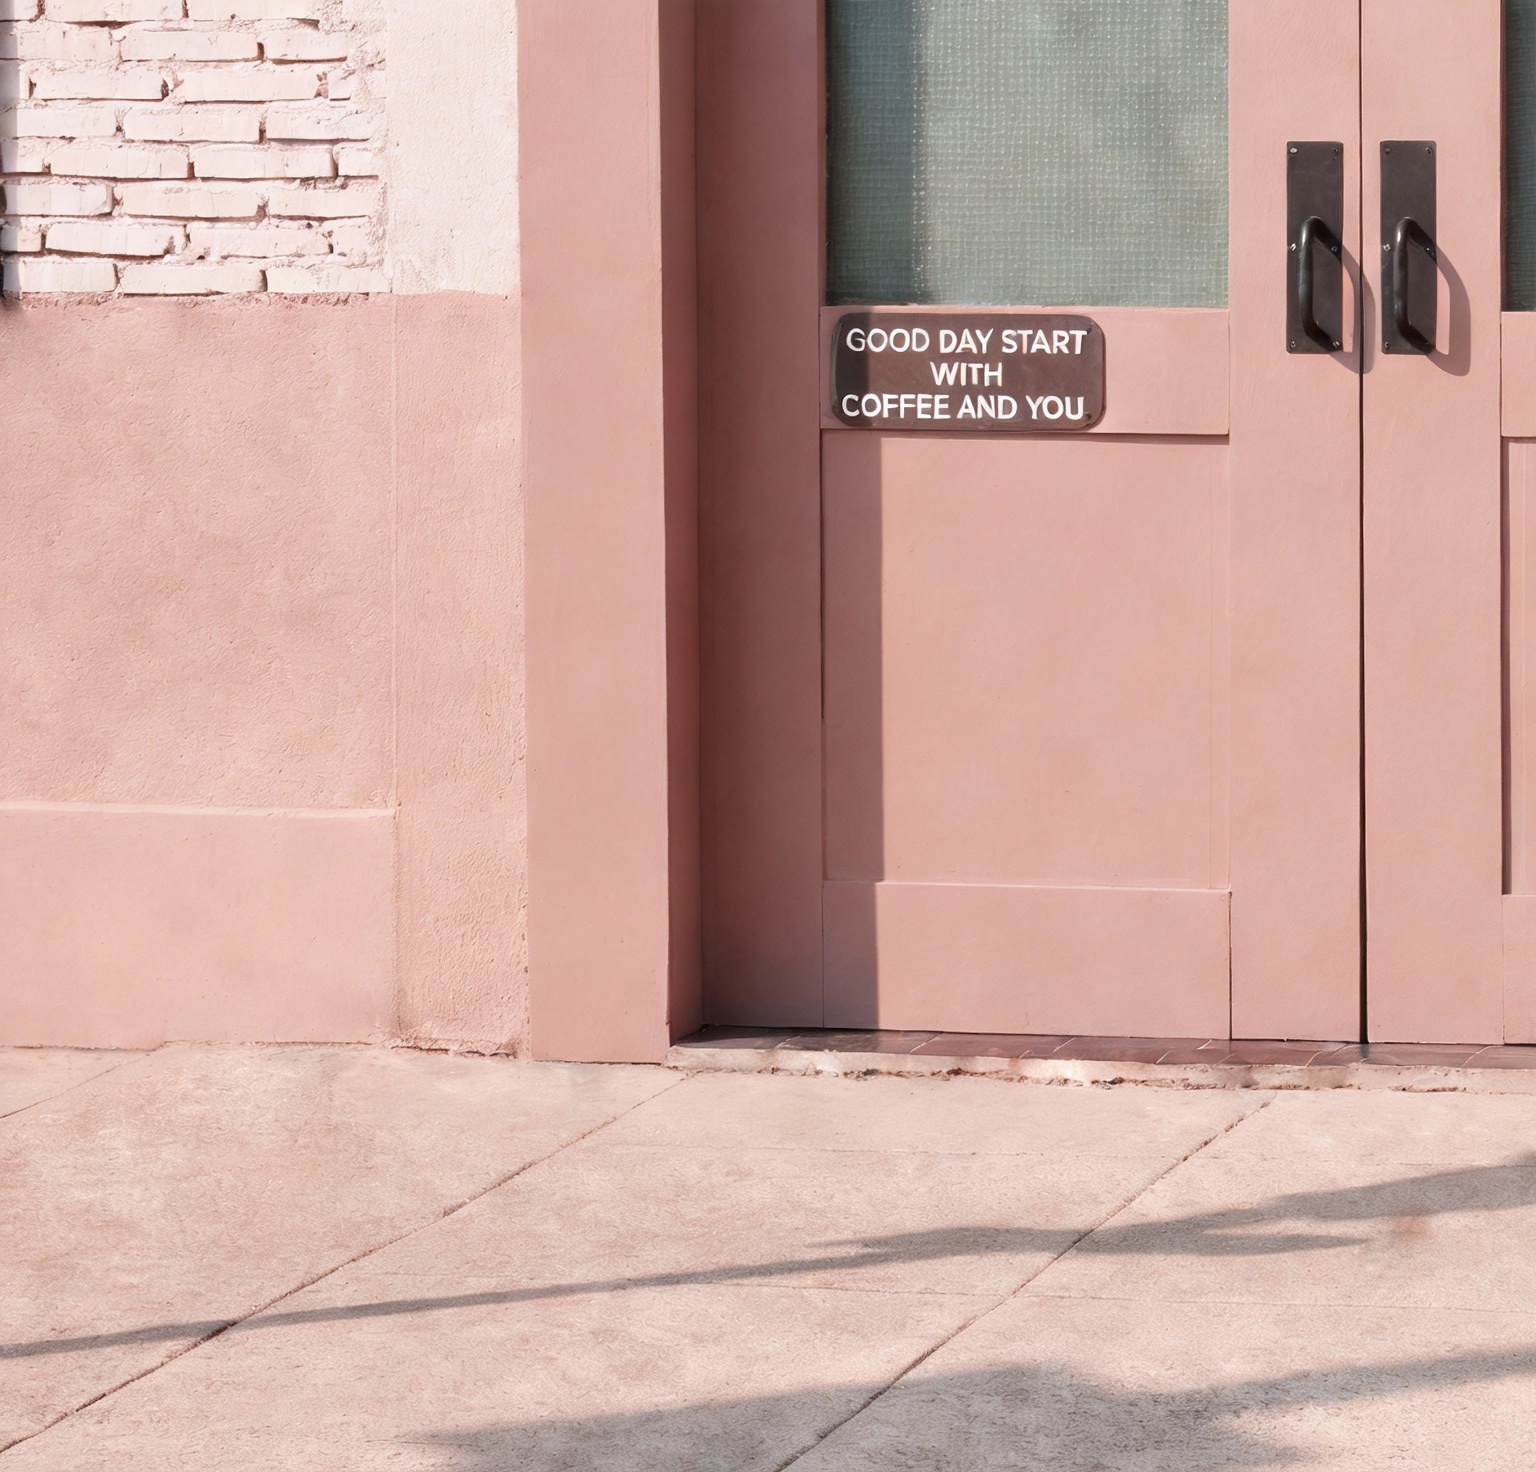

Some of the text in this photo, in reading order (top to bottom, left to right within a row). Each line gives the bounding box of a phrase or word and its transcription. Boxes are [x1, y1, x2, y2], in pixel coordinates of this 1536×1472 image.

[845, 327, 1088, 355] GOOD DAY START
[929, 361, 1003, 387] WITH
[841, 393, 1085, 420] COFFEE AND YOU
